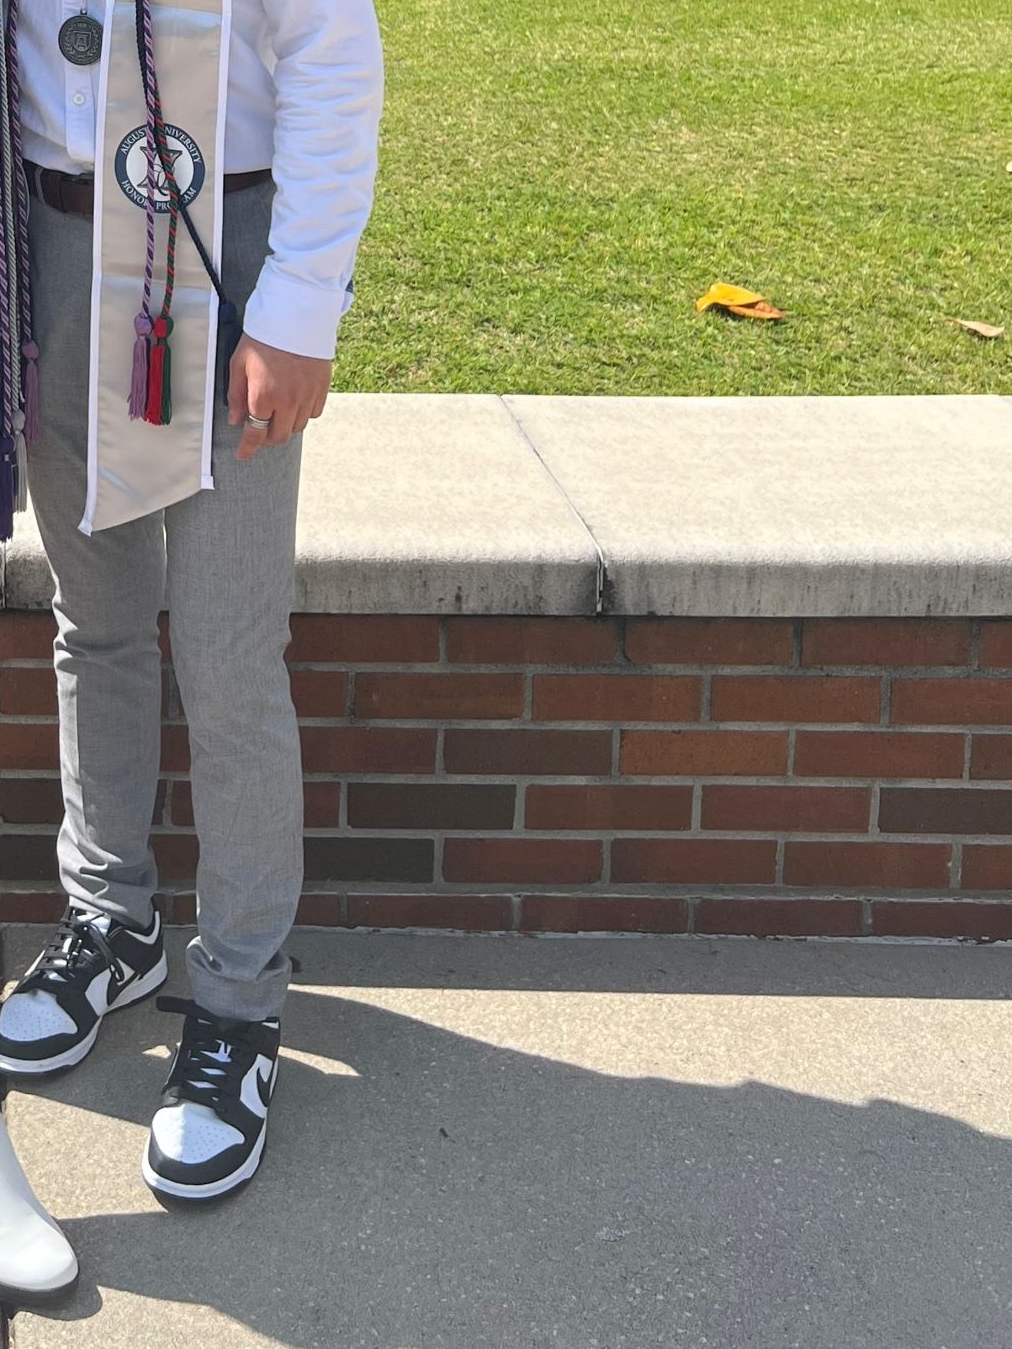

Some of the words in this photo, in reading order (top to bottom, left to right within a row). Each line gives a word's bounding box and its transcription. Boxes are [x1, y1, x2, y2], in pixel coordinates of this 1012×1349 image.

[120, 127, 149, 154] AUGUST
[165, 125, 202, 163] NIVERSITY
[156, 187, 196, 210] PRAM
